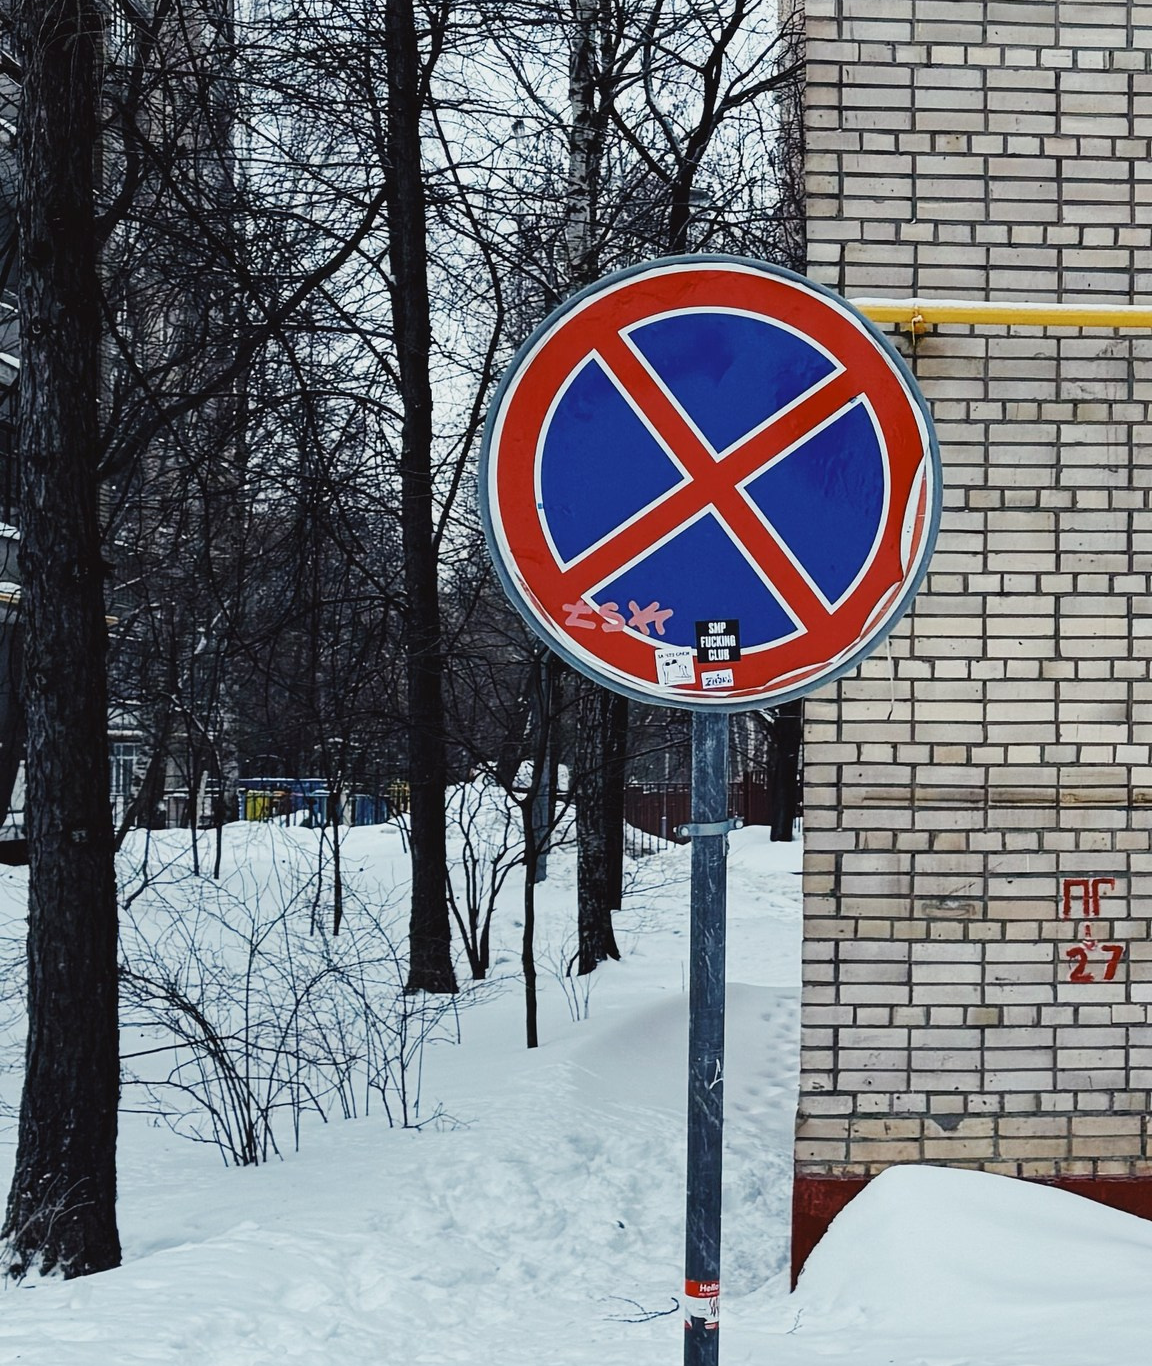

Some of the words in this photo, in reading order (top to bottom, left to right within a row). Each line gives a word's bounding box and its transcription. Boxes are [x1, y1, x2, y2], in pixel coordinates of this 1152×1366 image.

[708, 622, 726, 634] SMP
[700, 635, 736, 648] FUCKING
[708, 648, 730, 661] CLUB
[1066, 945, 1125, 982] 27
